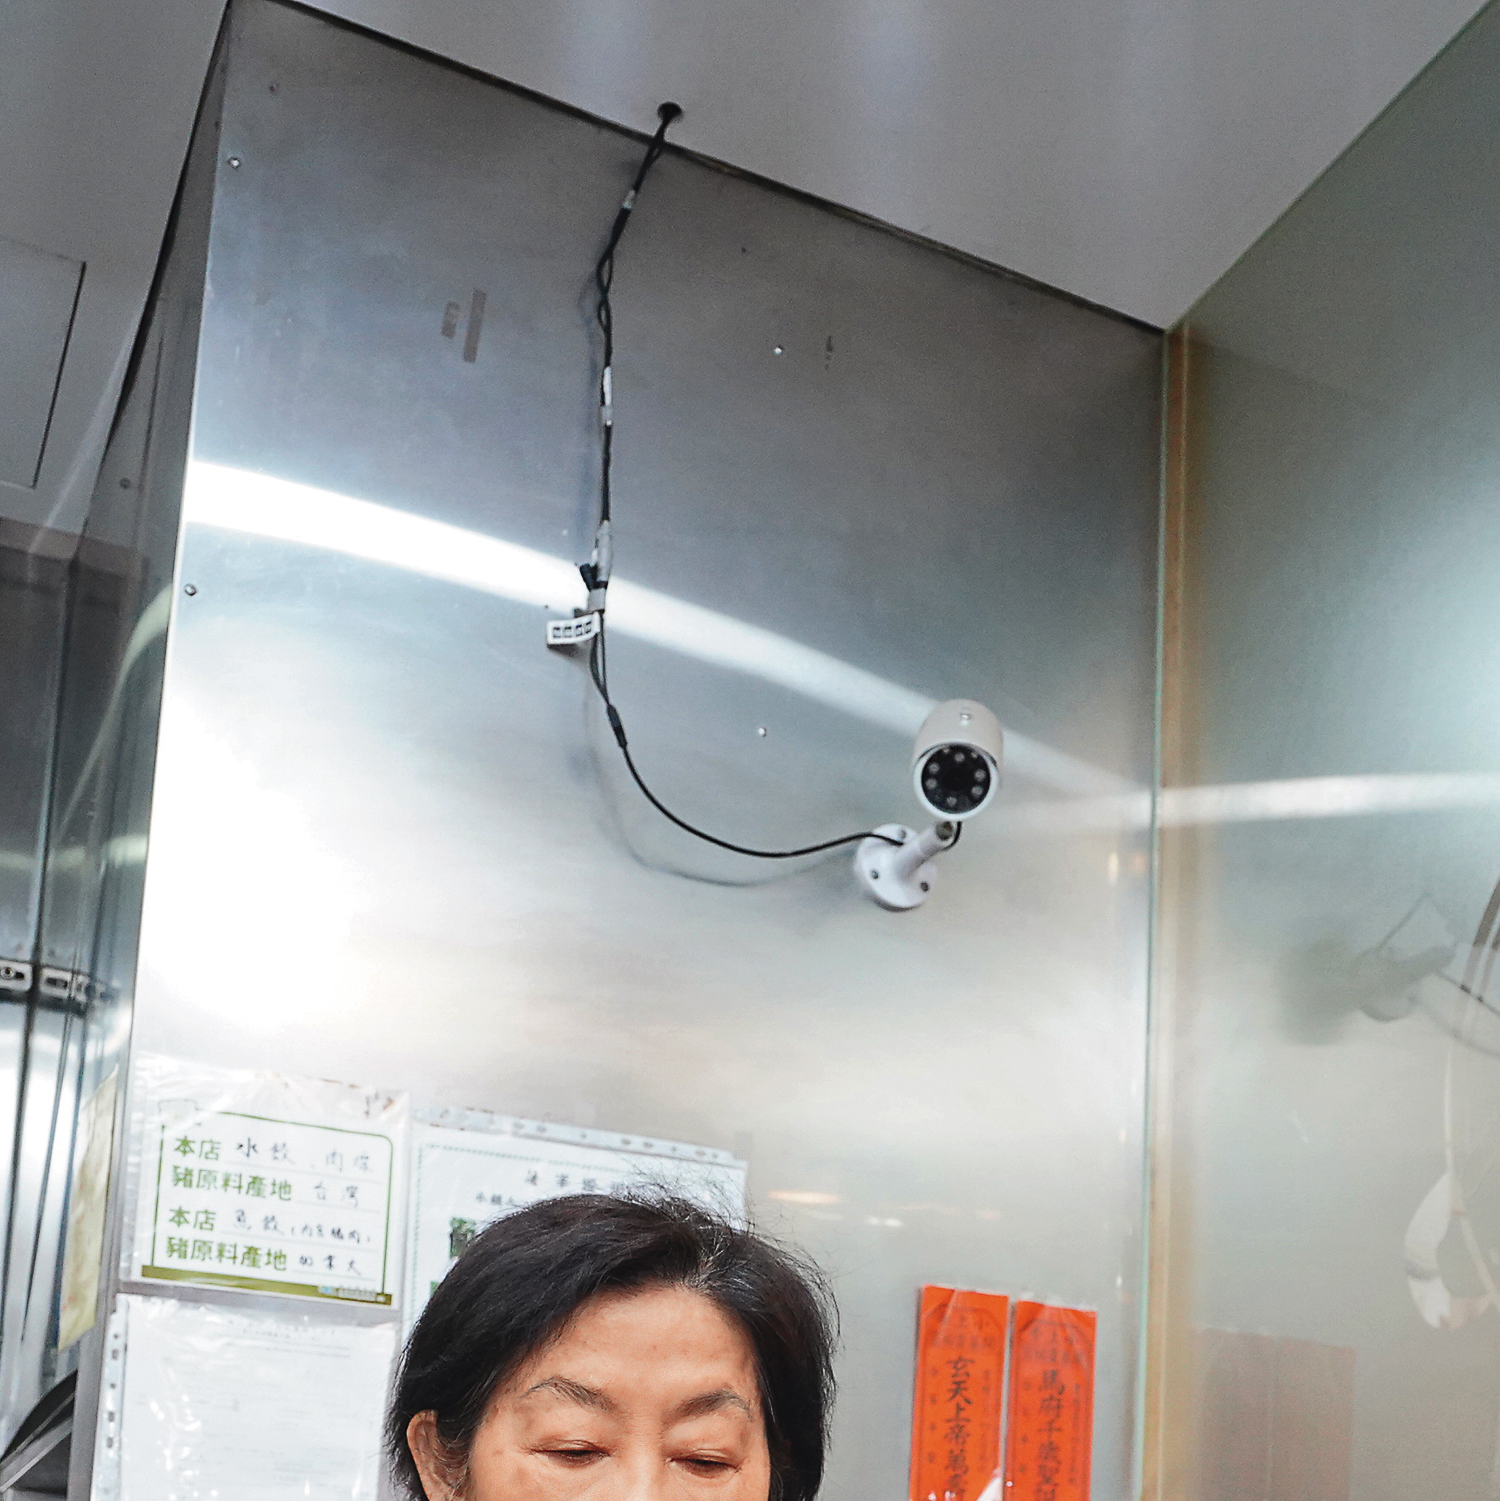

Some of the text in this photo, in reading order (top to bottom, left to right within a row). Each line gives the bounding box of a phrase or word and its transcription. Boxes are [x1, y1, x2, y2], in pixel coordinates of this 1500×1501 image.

[174, 1135, 222, 1162] 本店
[171, 1165, 292, 1201] 豬原料產地
[168, 1206, 217, 1232] 本店
[166, 1236, 287, 1272] 豬原料產地
